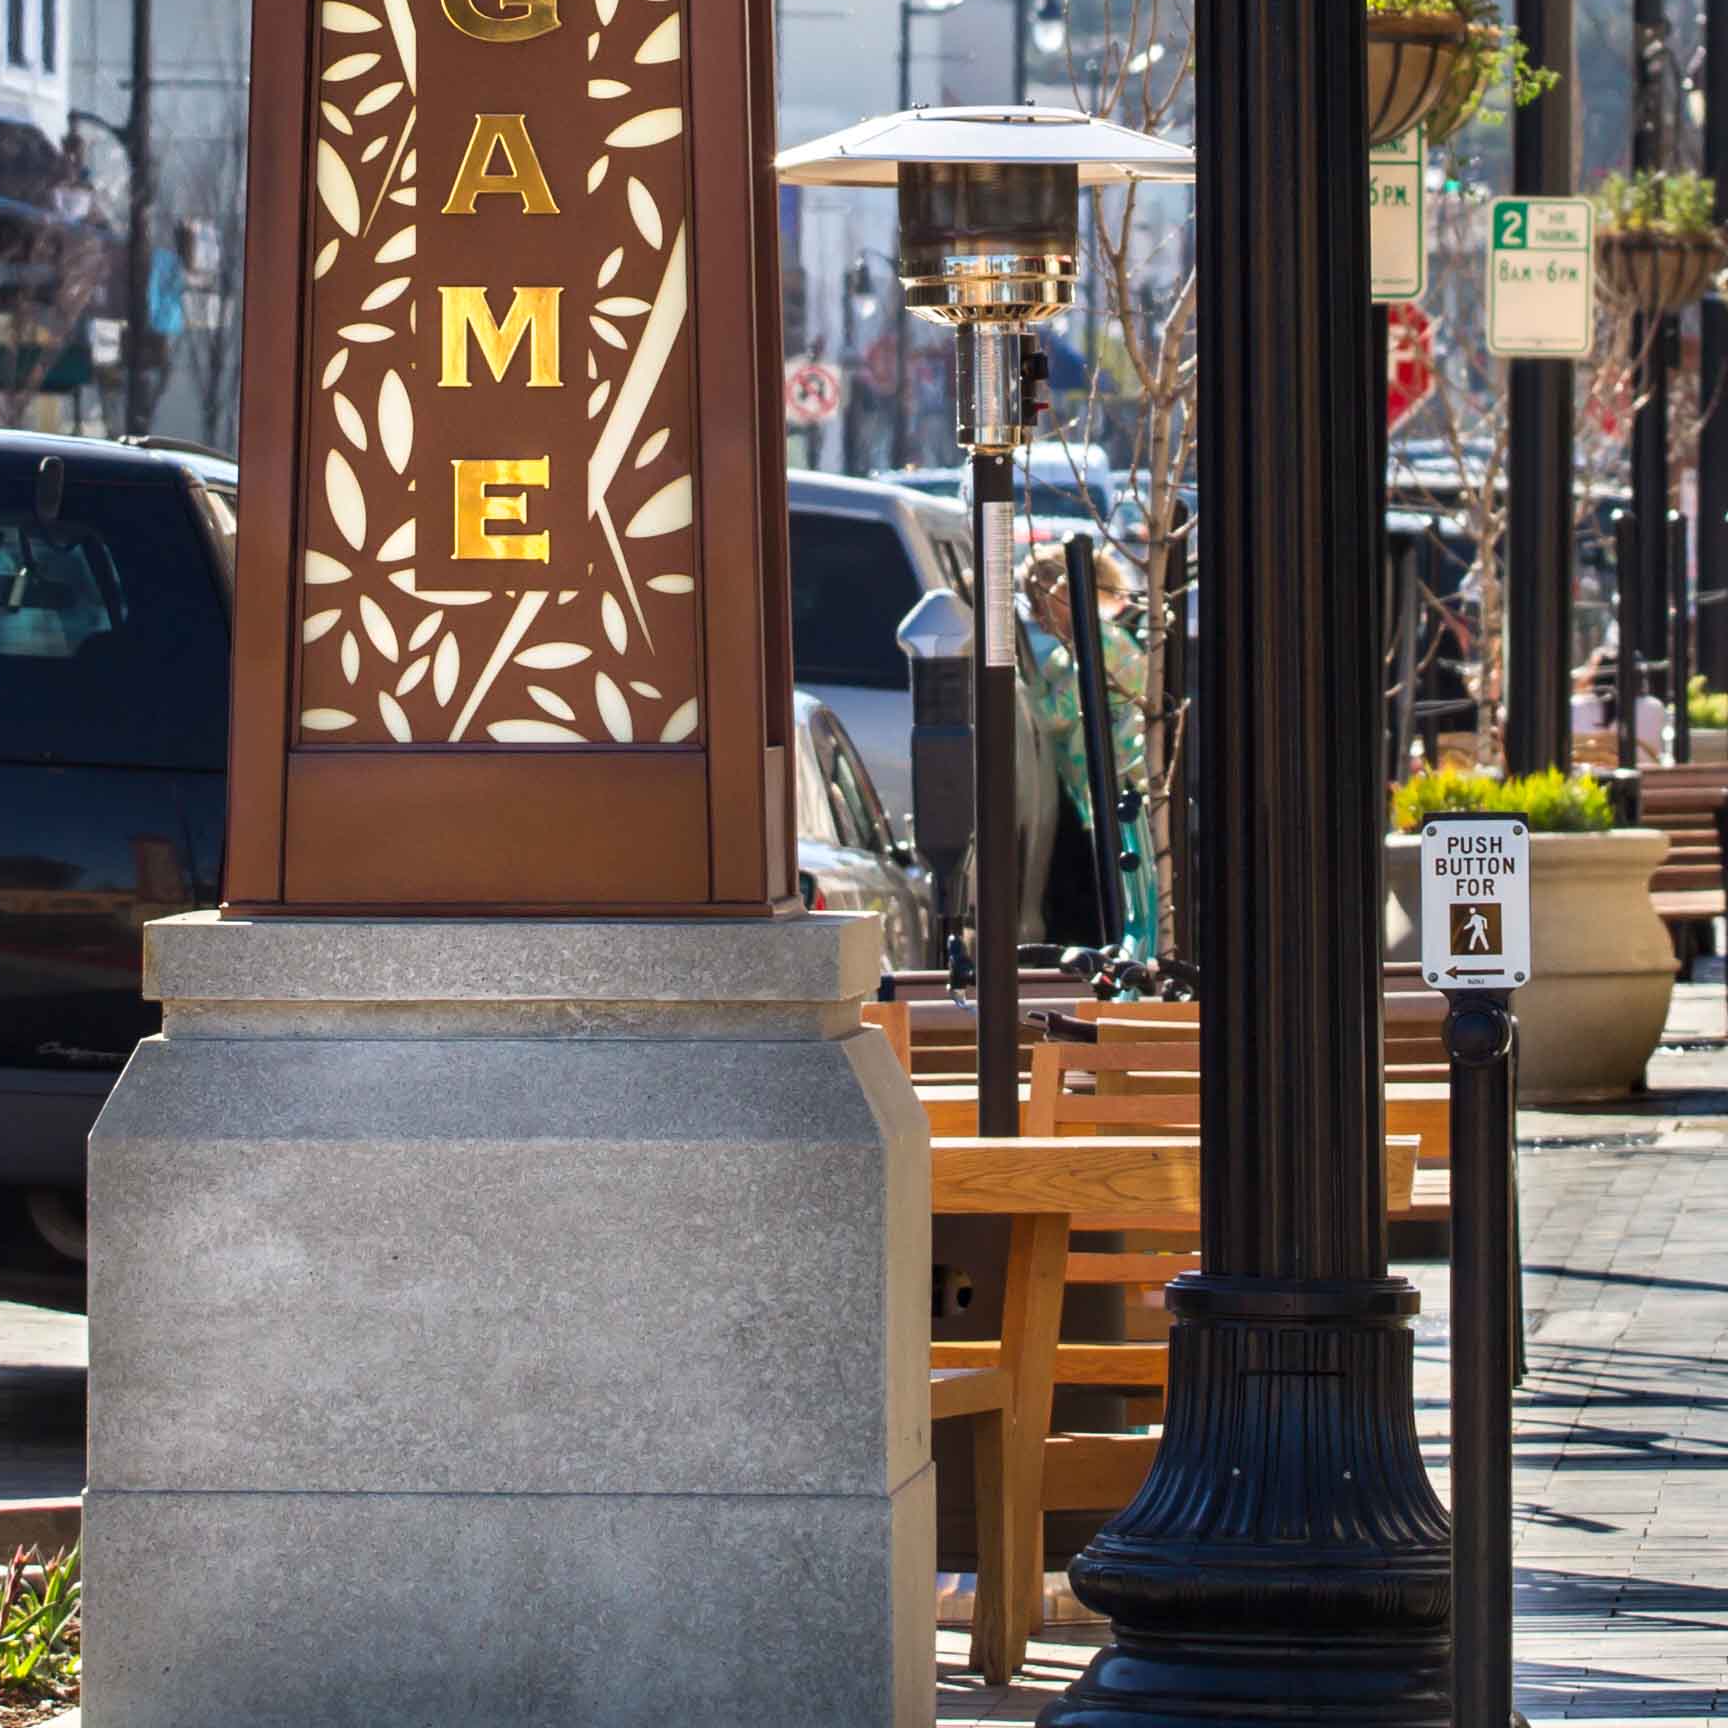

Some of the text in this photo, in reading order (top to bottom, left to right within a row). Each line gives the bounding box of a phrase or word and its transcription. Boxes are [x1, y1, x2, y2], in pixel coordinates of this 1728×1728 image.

[1501, 210, 1522, 245] 2
[1447, 836, 1503, 854] PUSH
[1435, 857, 1515, 876] BUTTON
[1456, 879, 1496, 897] FOR
